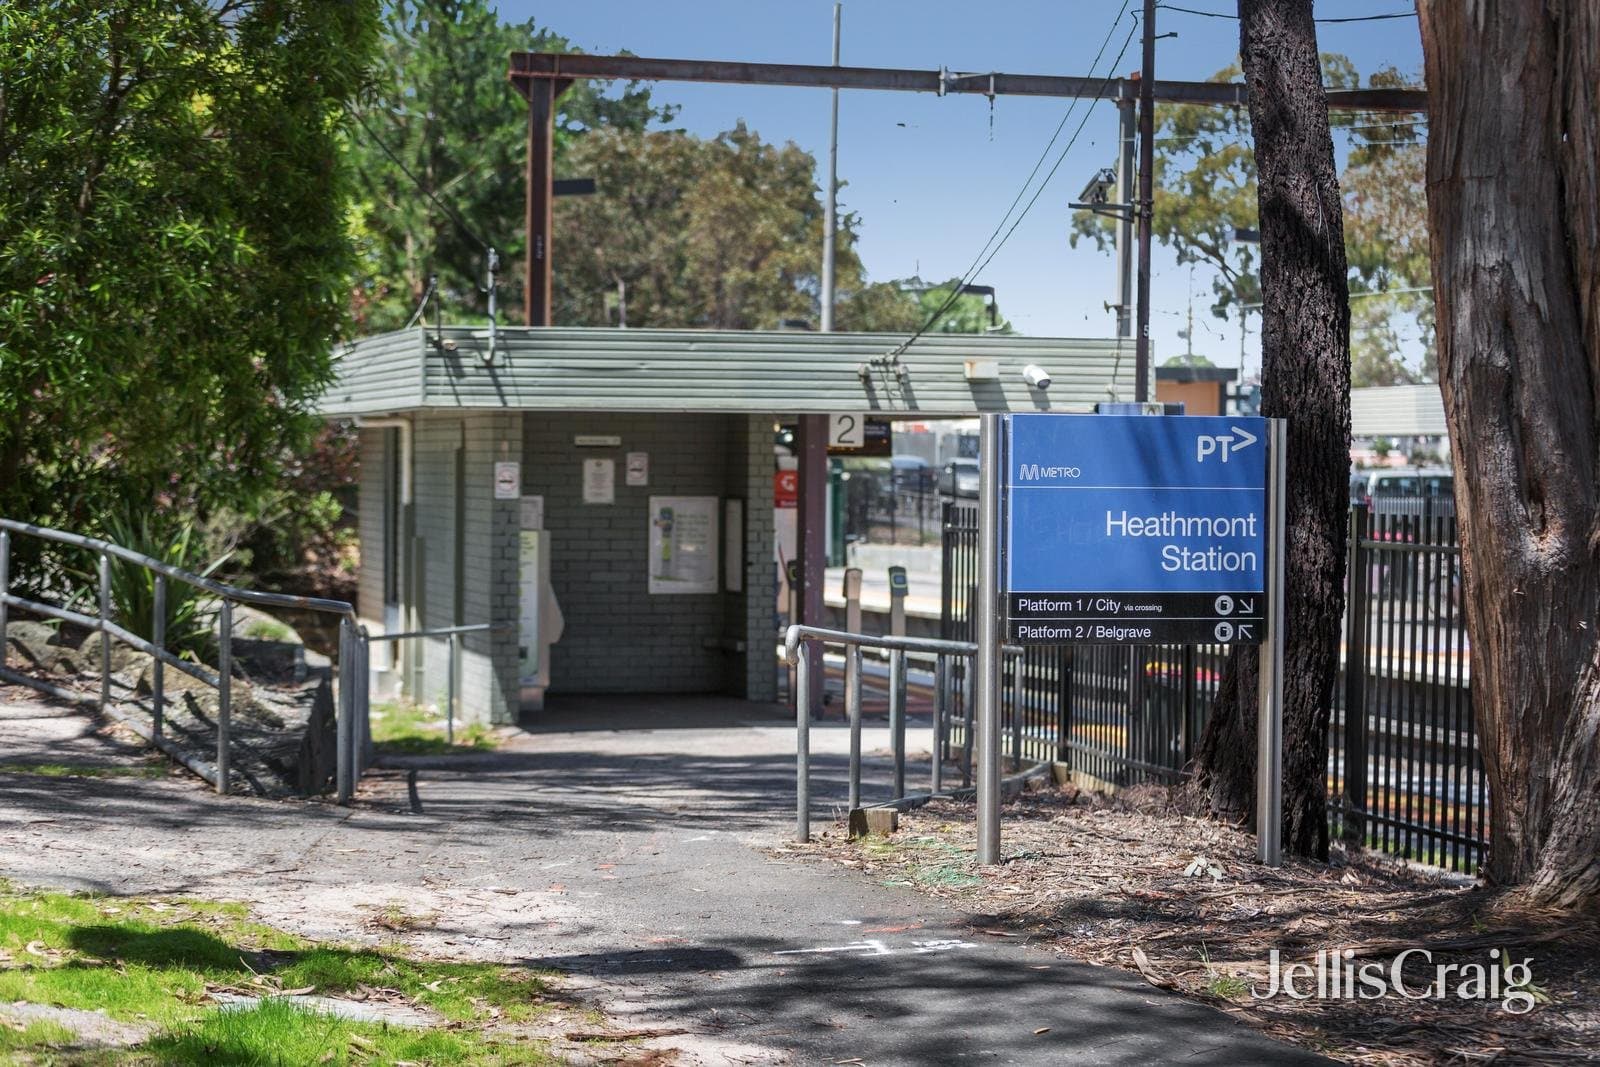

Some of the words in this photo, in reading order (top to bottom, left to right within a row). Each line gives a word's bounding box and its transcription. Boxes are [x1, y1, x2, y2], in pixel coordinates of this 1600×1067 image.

[837, 415, 855, 444] 2
[1040, 467, 1081, 478] METRO
[1106, 510, 1257, 537] Heathmont
[1161, 545, 1256, 572] Station
[1018, 599, 1072, 611] Platform
[1076, 600, 1082, 611] 1
[1096, 599, 1121, 614] City
[1135, 604, 1163, 613] crossing
[1018, 625, 1072, 638] Platform
[1075, 626, 1083, 638] 2
[1096, 626, 1151, 640] Belgrave
